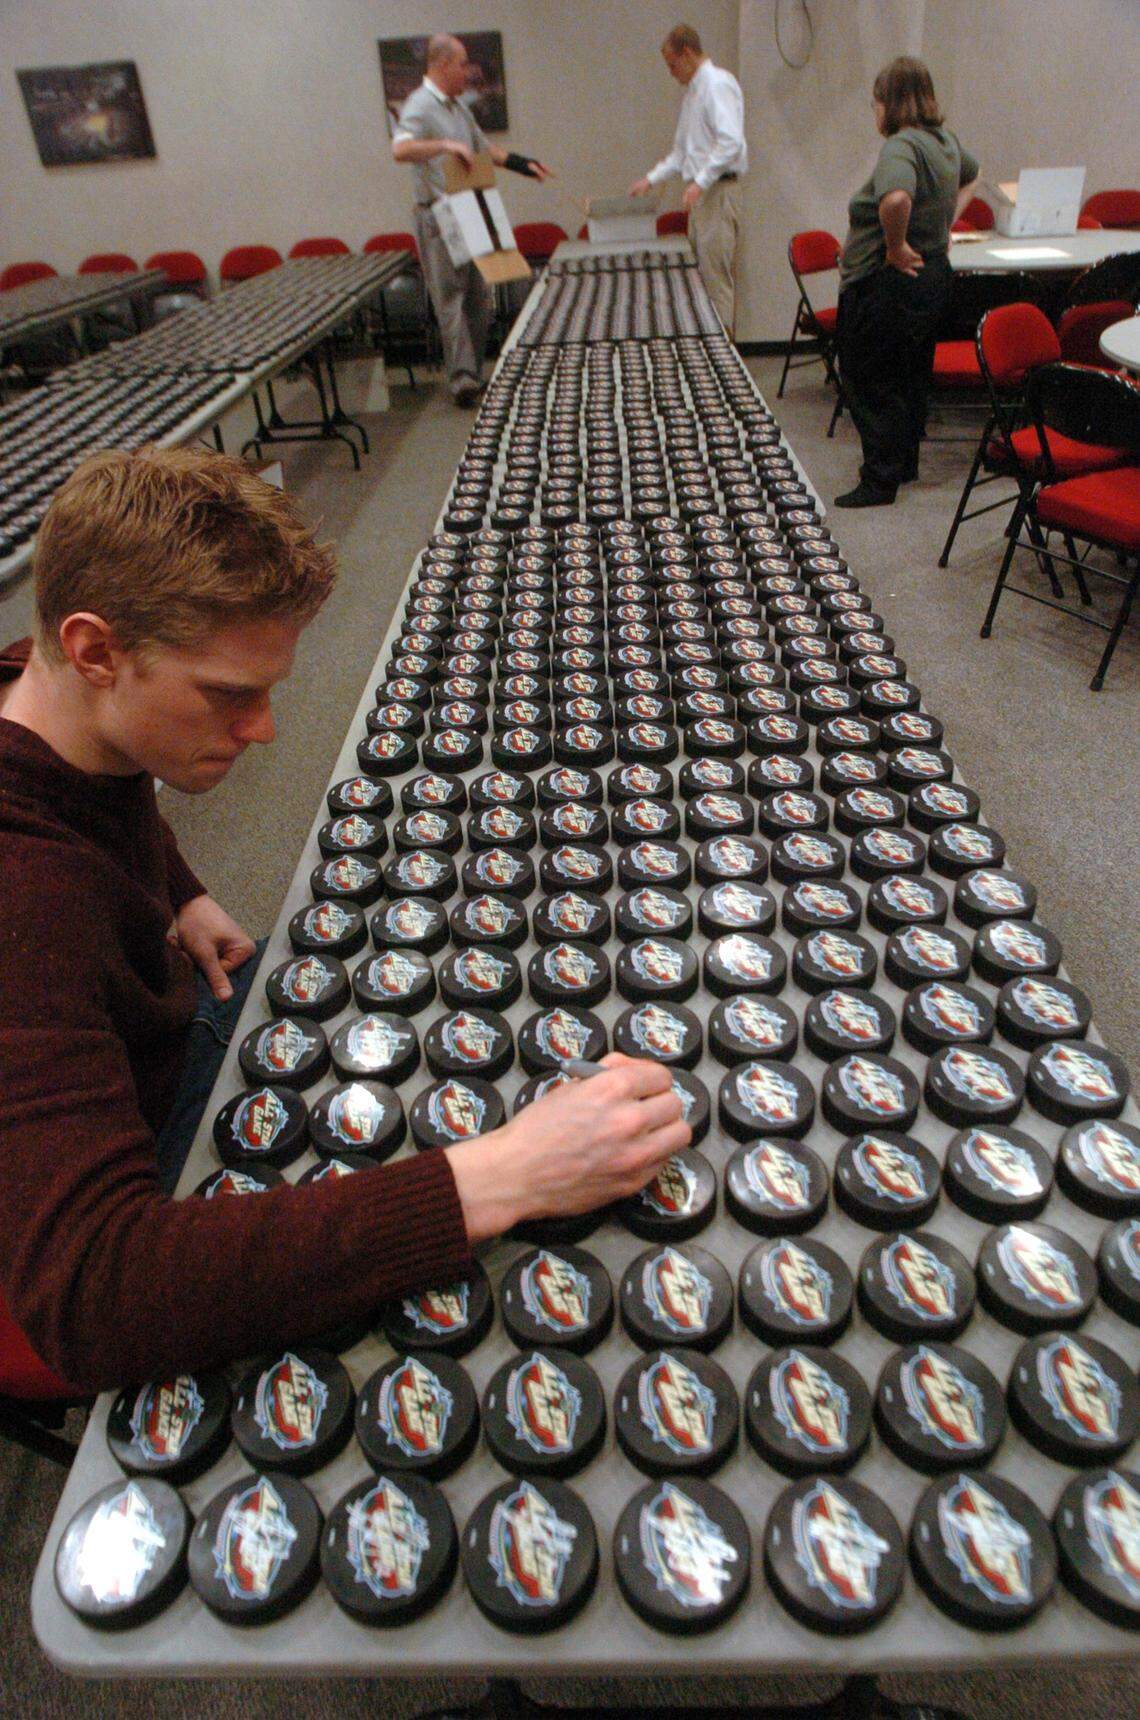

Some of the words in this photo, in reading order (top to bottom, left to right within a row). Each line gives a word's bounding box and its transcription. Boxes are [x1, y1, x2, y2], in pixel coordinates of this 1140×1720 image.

[265, 1094, 278, 1118] ALL
[252, 1105, 265, 1136] GAME
[261, 1122, 272, 1146] STAR
